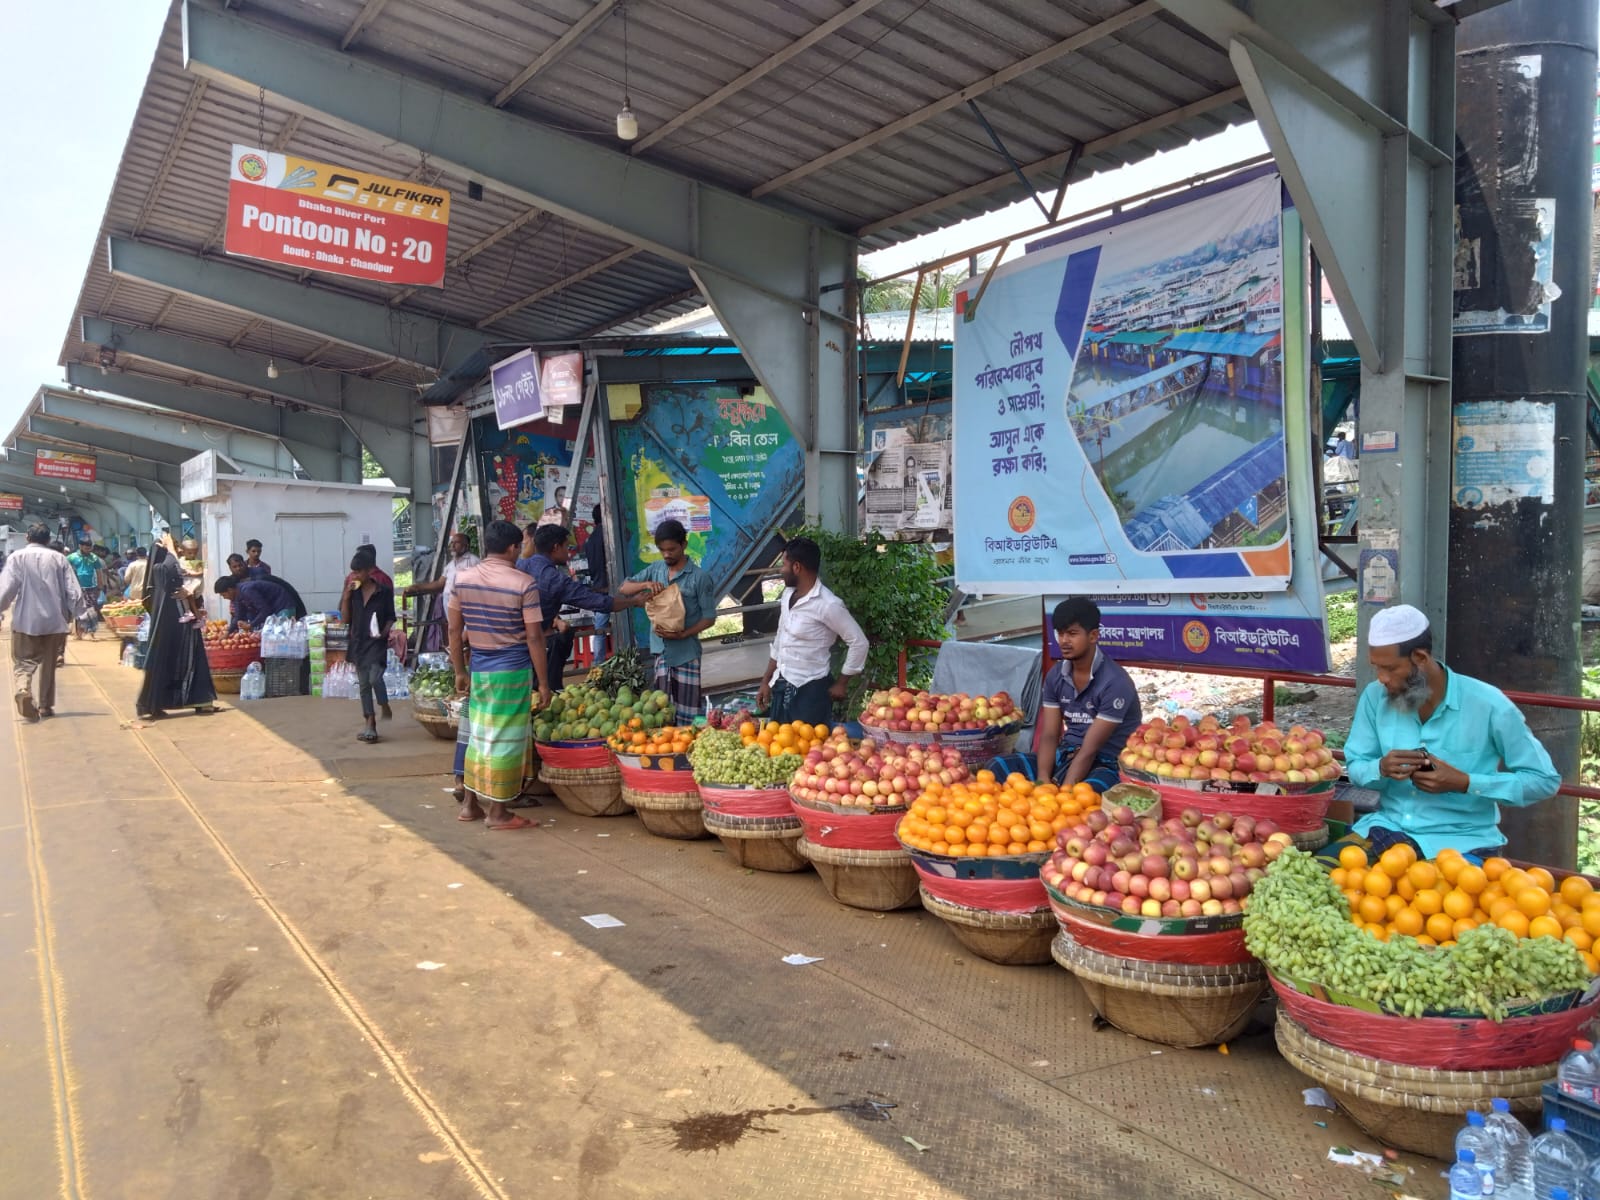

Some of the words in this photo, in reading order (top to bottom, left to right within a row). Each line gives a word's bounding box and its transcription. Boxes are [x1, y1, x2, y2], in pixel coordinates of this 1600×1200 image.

[358, 194, 440, 220] STEEL
[362, 182, 444, 207] JULFIKAR
[298, 199, 332, 214] Dhaka
[334, 207, 362, 220] River
[363, 213, 386, 225] Port
[242, 204, 349, 248] Pontoon
[355, 227, 386, 254] No
[402, 238, 432, 264] 20
[283, 244, 310, 259] Route
[315, 249, 344, 265] Dhaka
[350, 257, 394, 274] Chandpur
[1009, 330, 1043, 358] নৌপথ
[974, 358, 1044, 390] পরিবেশবান্ধব
[998, 399, 1006, 416] ও
[754, 432, 778, 446] তেল
[989, 428, 1020, 454] আসুন
[1023, 422, 1046, 443] একে
[992, 456, 1019, 477] রক্ষা
[984, 534, 1058, 553] বিআইডব্লিউটিএ
[1214, 626, 1300, 648] বিআইডব্লিউটিএ
